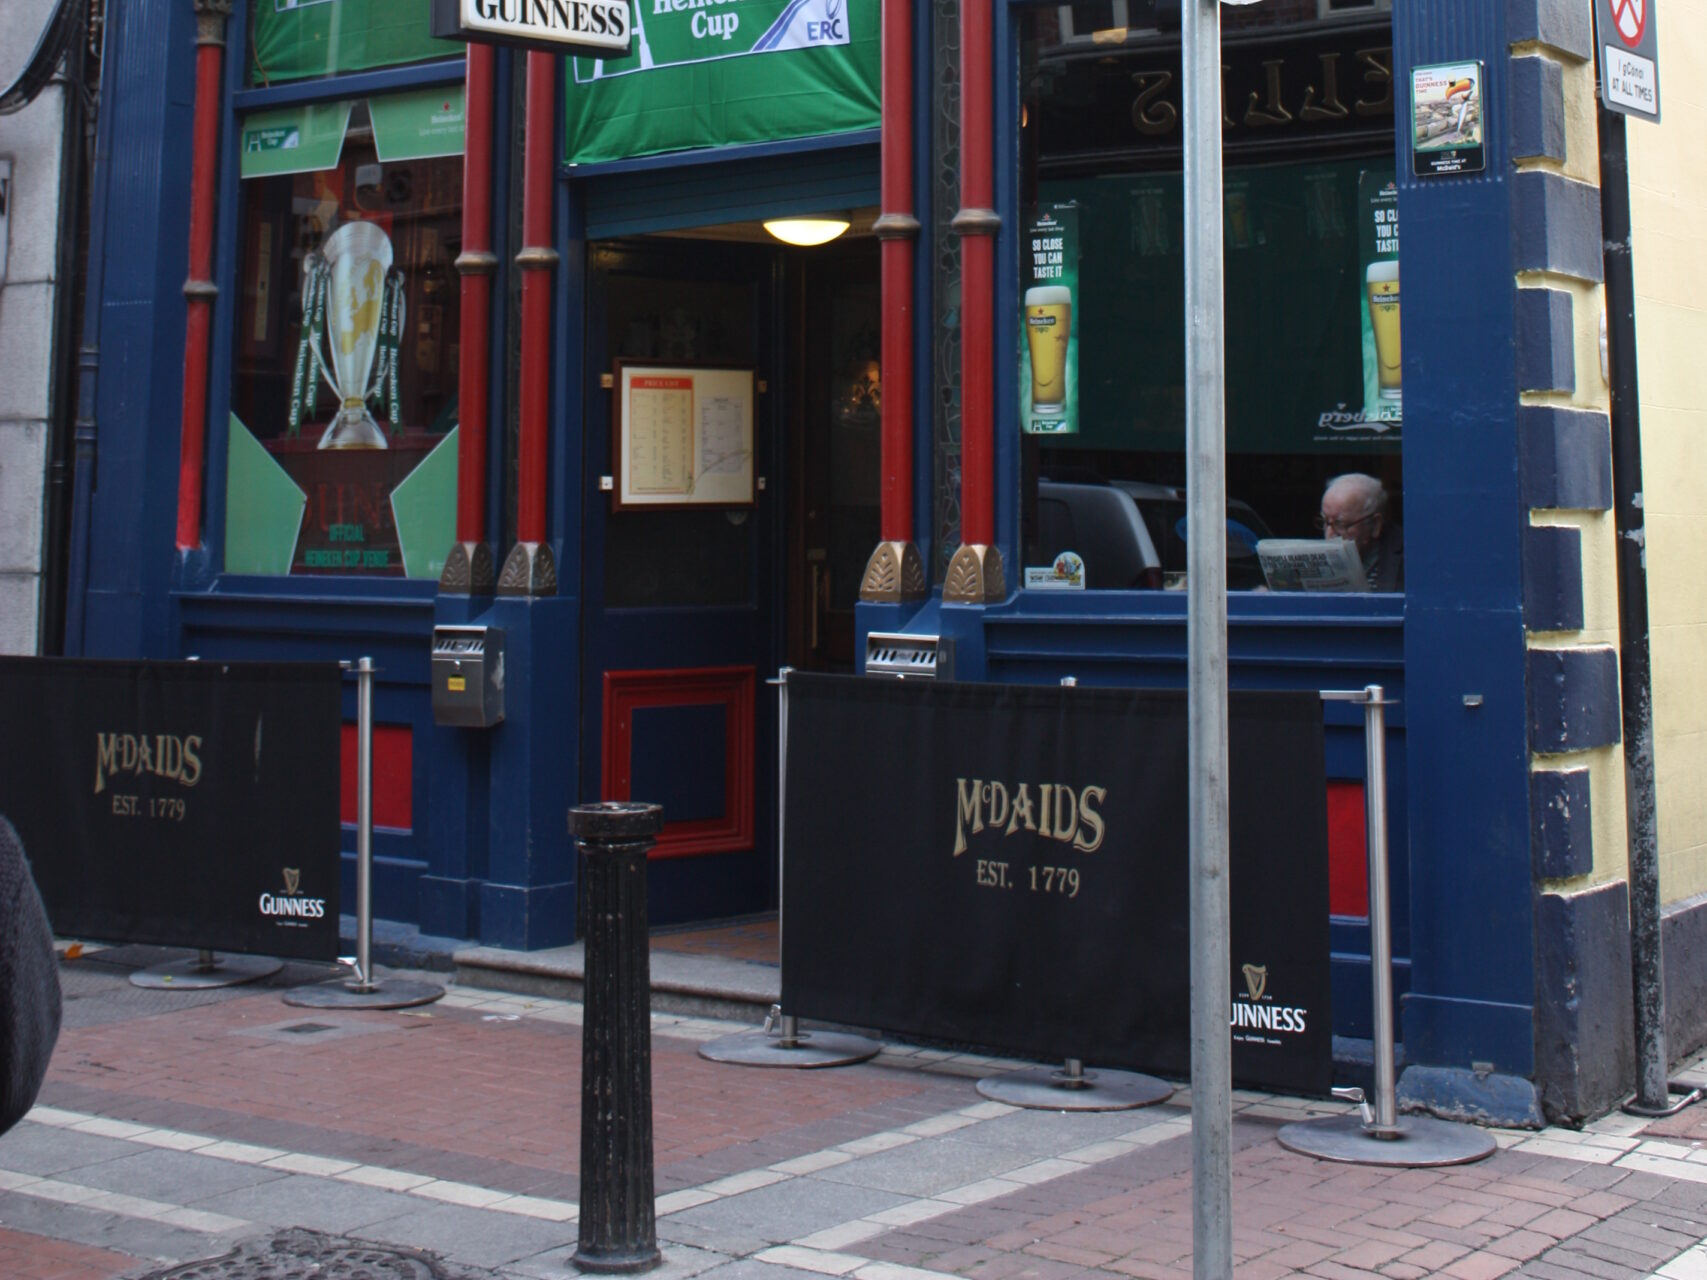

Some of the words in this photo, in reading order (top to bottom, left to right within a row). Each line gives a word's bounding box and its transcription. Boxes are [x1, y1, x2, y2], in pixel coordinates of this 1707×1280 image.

[690, 10, 739, 40] Cup
[807, 18, 843, 41] ERC
[1634, 84, 1653, 103] TIMES
[1374, 210, 1385, 222] SO
[1376, 224, 1392, 238] YOU
[1032, 239, 1041, 251] SO
[1043, 238, 1063, 251] CLOSE
[1033, 252, 1047, 265] YOU
[1048, 251, 1063, 264] CAN
[1033, 266, 1054, 279] TASTE
[1055, 265, 1063, 278] IT
[289, 399, 301, 425] Cup
[389, 400, 399, 424] Cup
[112, 795, 142, 816] EST.
[150, 797, 186, 822] 1779
[976, 859, 1013, 888] EST.
[1028, 865, 1081, 899] 1779
[259, 892, 325, 918] GUINNESS
[1230, 1002, 1307, 1033] UINNESS
